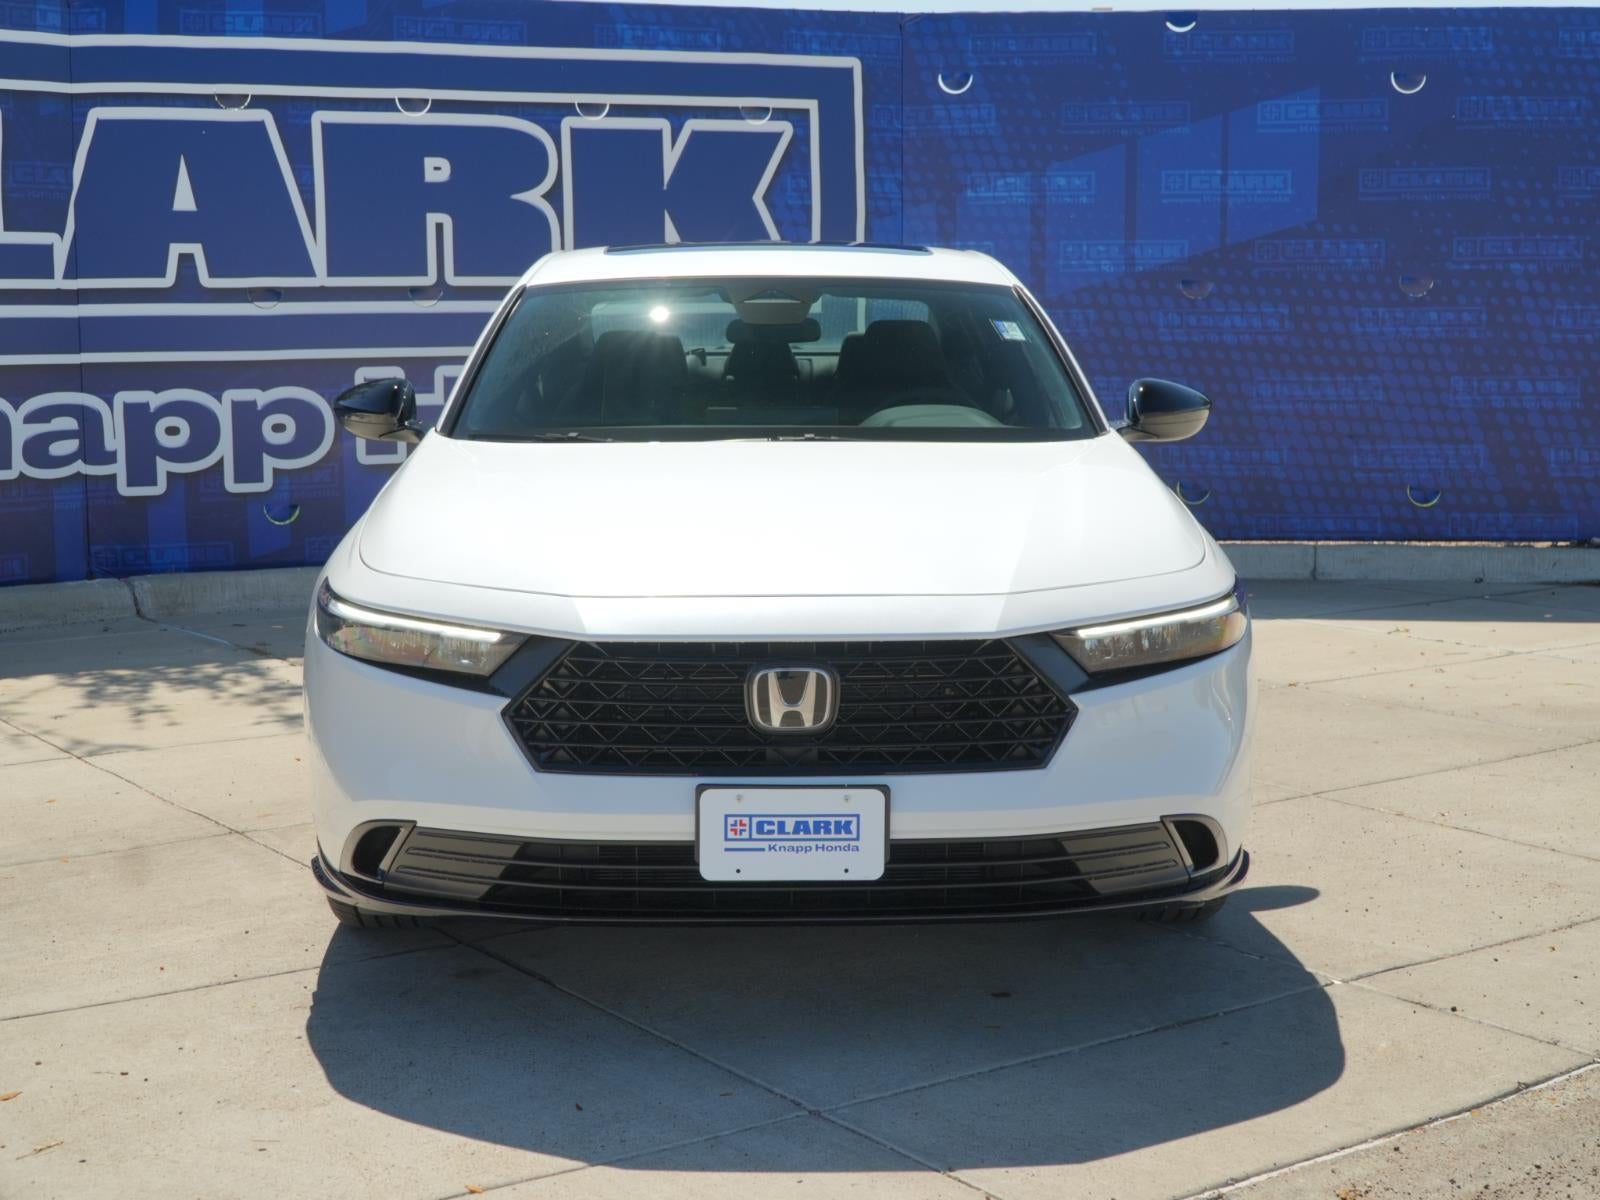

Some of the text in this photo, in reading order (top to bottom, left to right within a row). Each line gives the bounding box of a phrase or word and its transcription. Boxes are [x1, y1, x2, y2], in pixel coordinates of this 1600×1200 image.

[756, 820, 853, 835] CLARK
[768, 843, 860, 854] Knapp Honda
